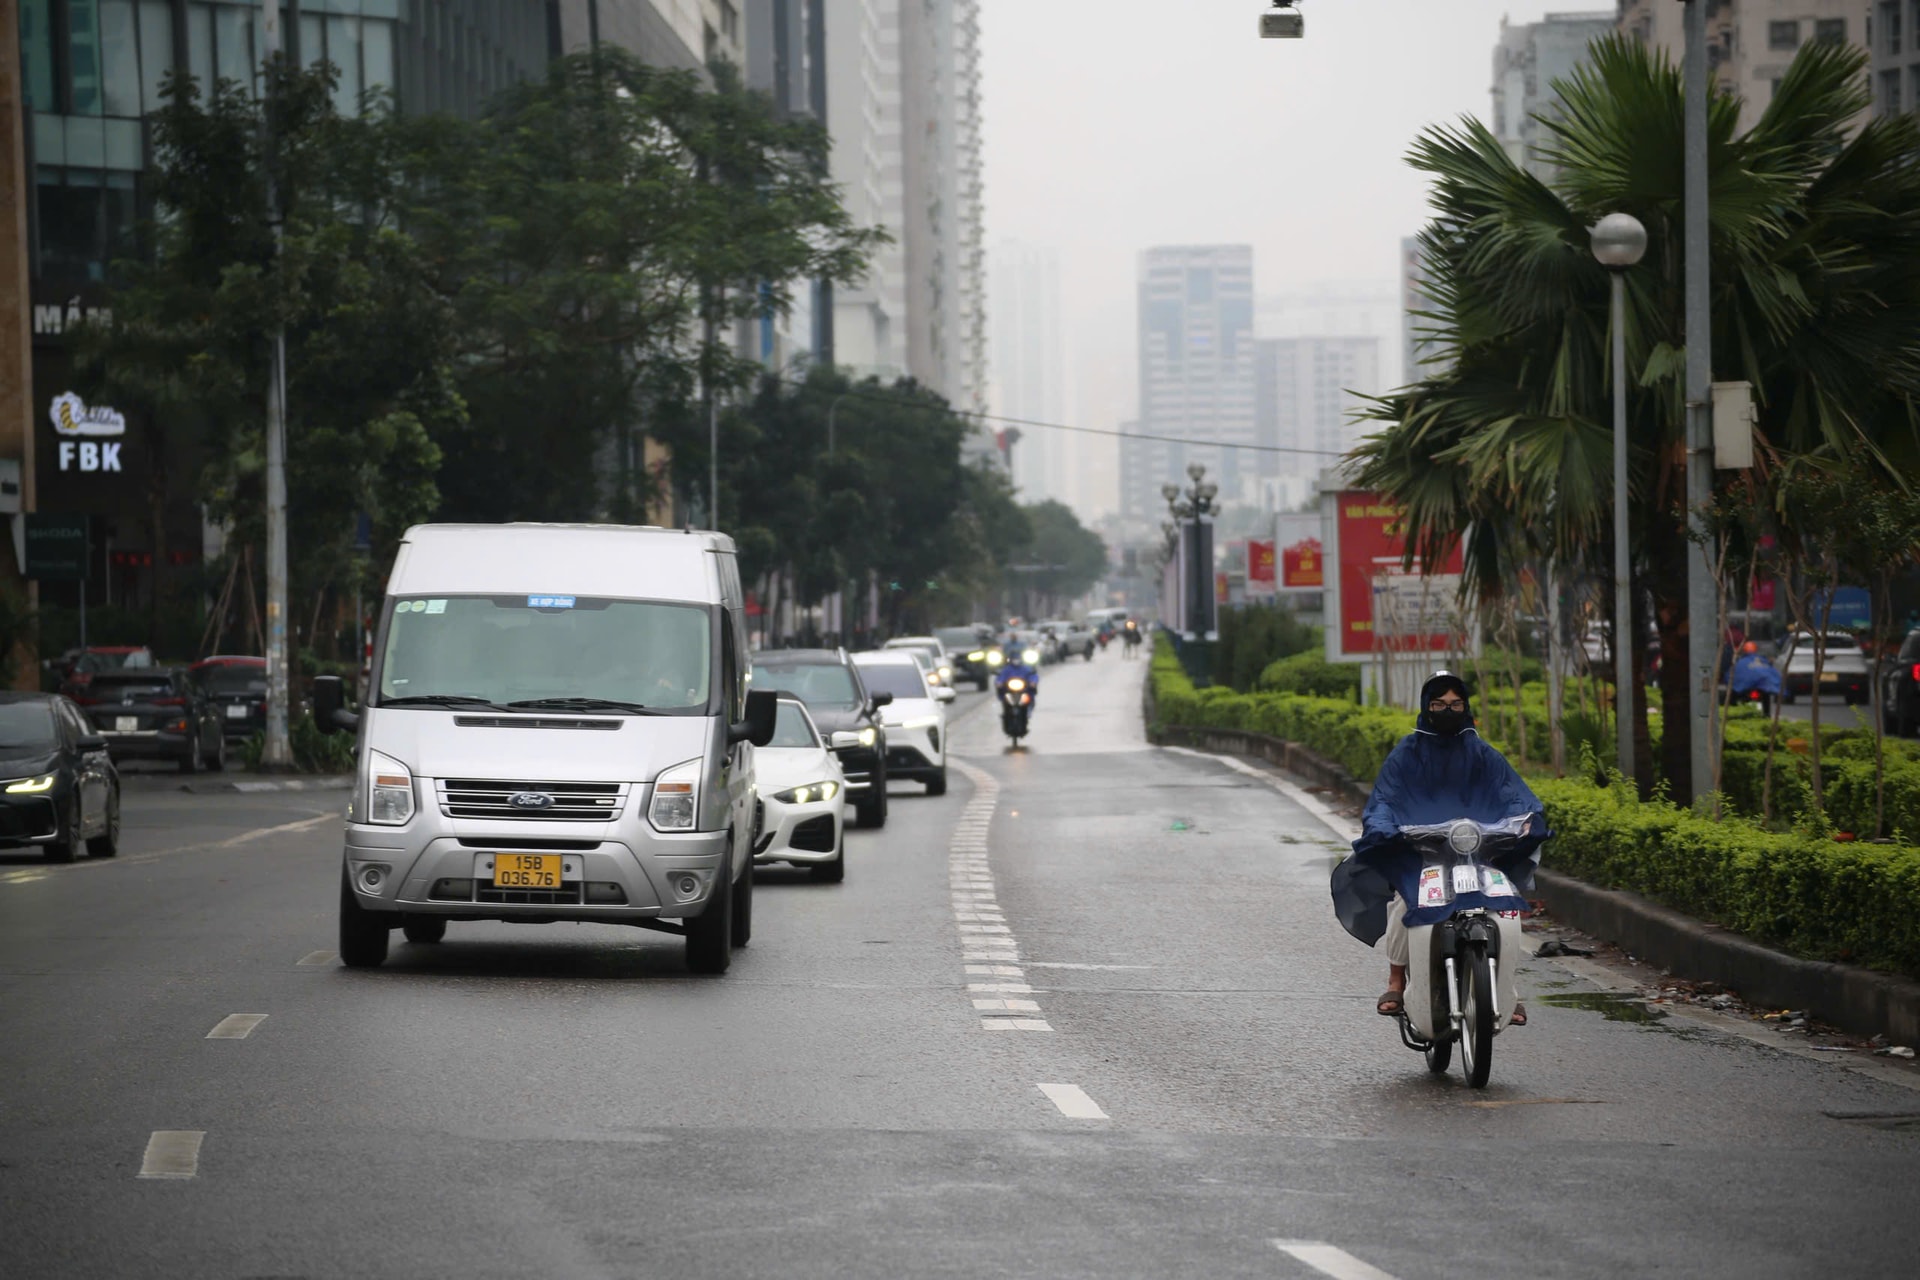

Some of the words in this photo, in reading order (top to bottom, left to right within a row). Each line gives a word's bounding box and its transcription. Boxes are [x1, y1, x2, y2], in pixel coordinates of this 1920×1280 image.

[59, 441, 122, 472] FBK
[517, 794, 544, 805] Ford
[516, 856, 543, 870] 15B
[501, 871, 554, 886] 036.76
